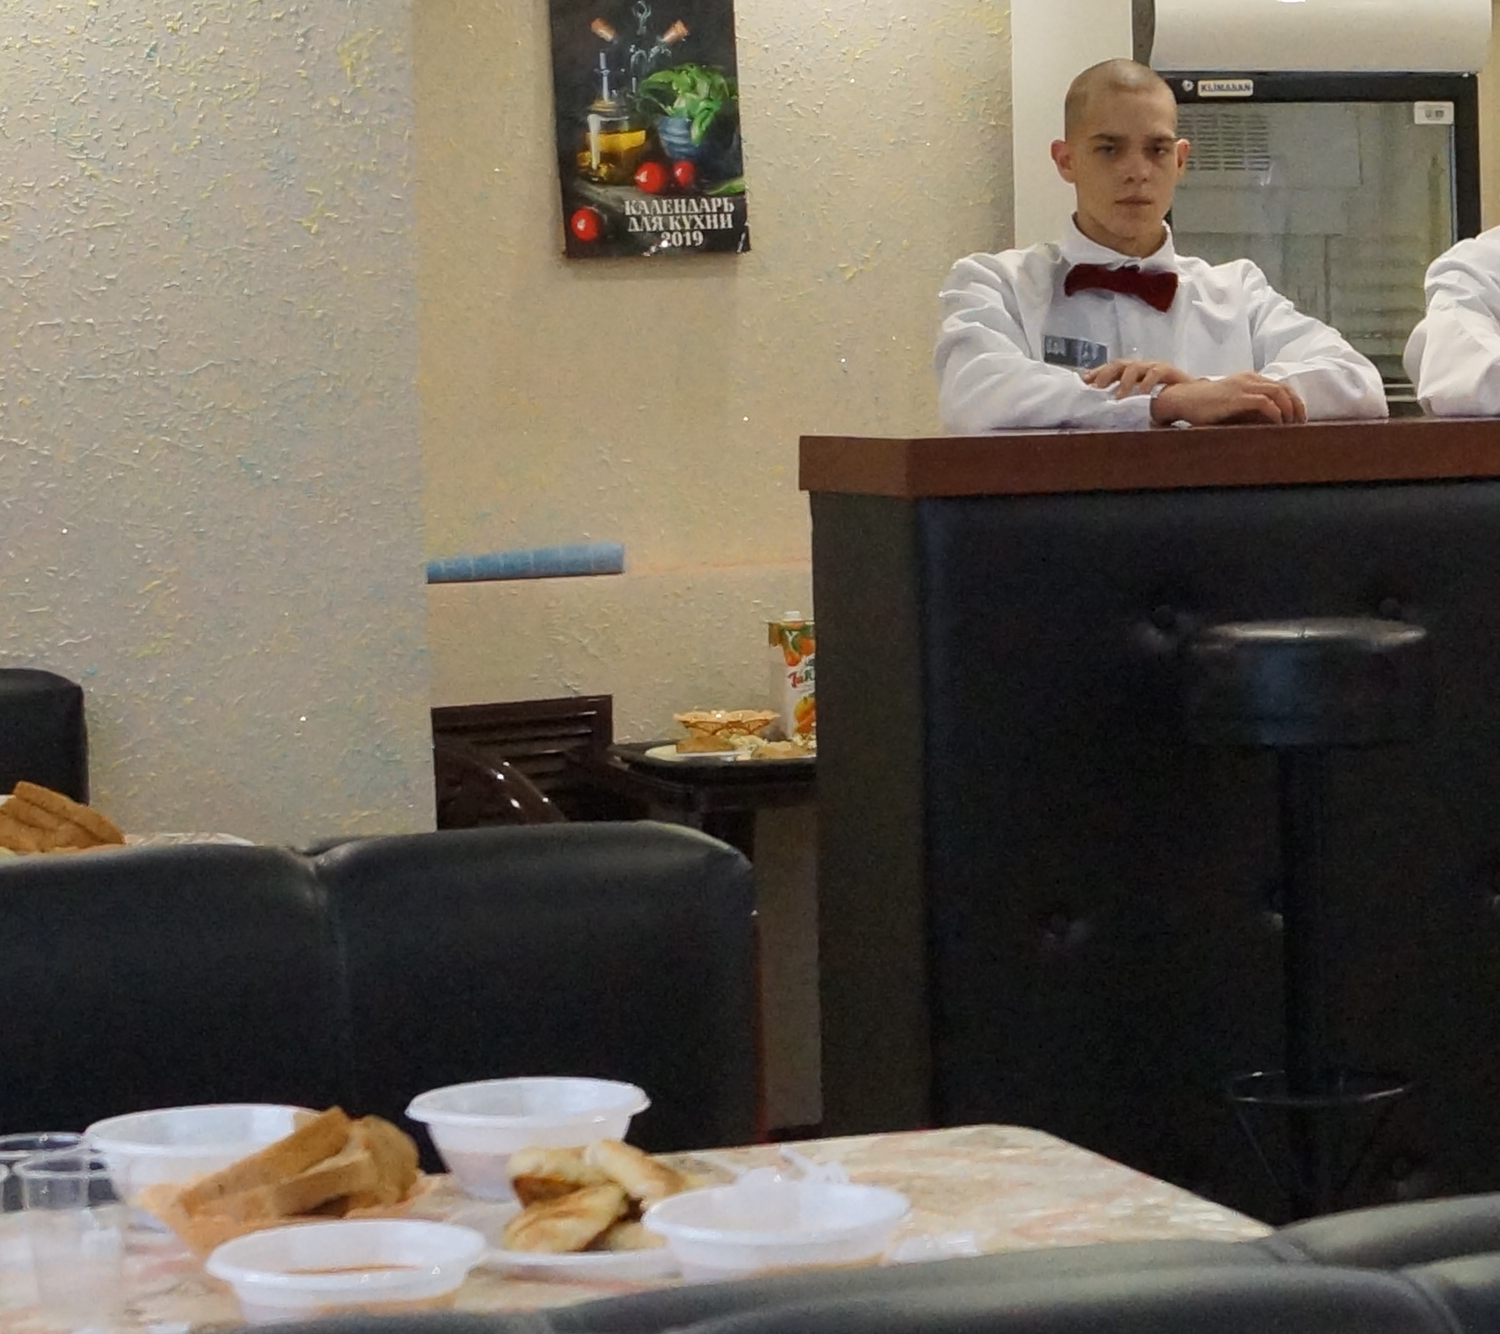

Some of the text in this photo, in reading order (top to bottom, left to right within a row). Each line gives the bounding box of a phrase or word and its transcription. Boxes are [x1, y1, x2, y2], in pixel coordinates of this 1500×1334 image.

[624, 197, 735, 216] КАЛЕНДАРЬ
[628, 213, 733, 232] ДЛЯ КУХНИ
[660, 230, 704, 247] 2019
